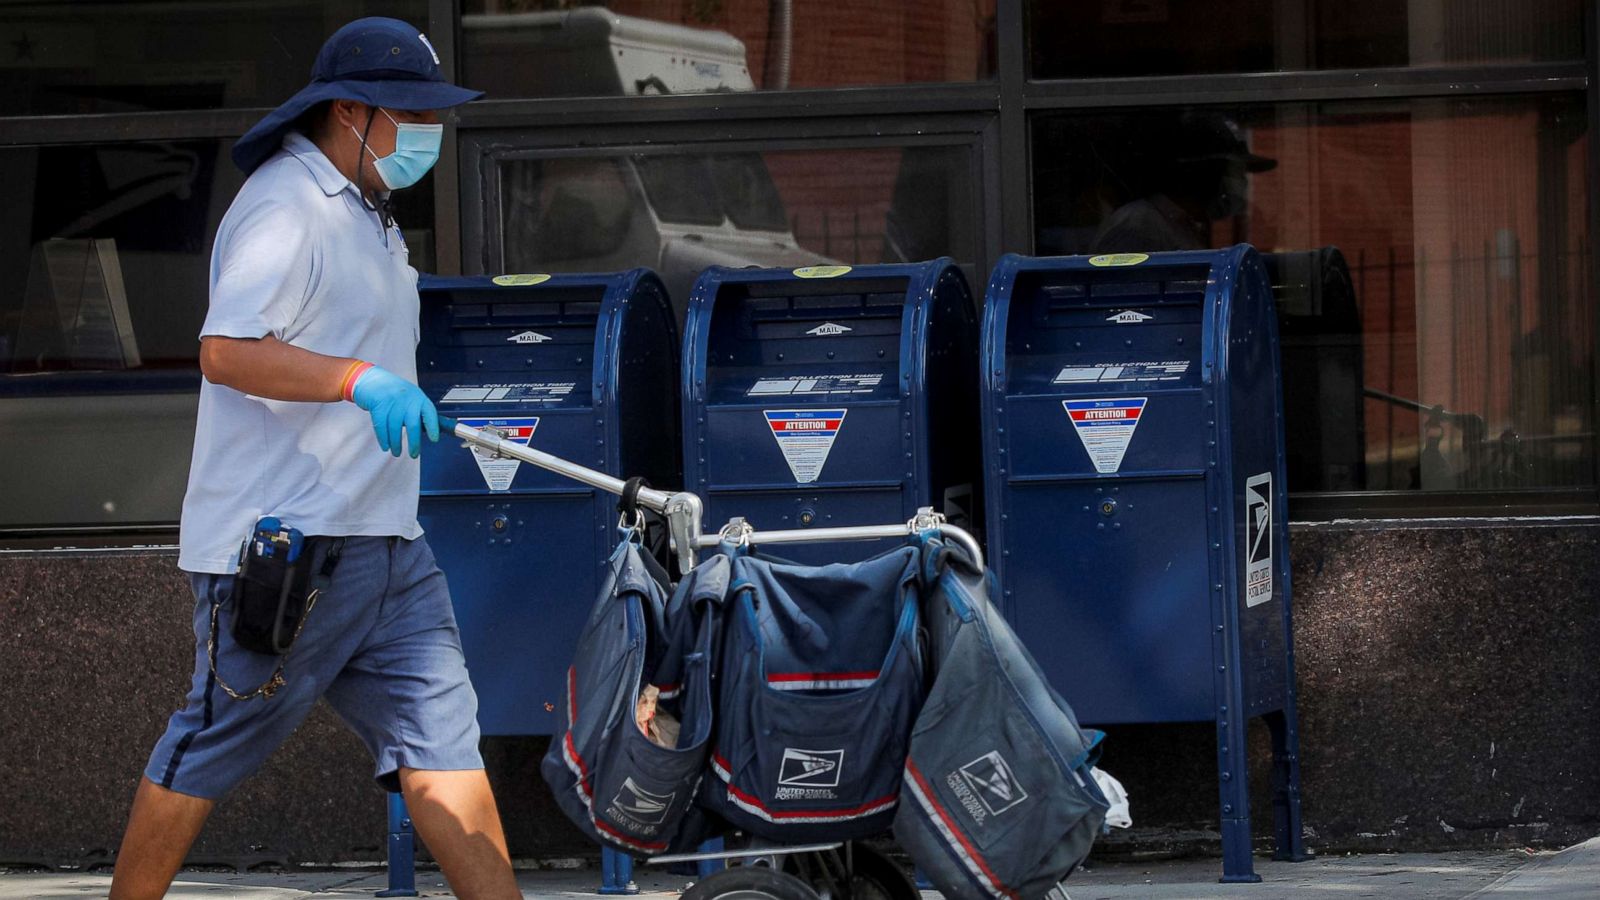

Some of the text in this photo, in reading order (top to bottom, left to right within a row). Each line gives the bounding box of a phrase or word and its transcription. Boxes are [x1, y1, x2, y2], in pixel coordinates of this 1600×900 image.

[819, 326, 839, 334] MAIL
[1085, 410, 1127, 419] ATTENTION
[785, 421, 827, 430] ATTENTION
[776, 786, 832, 796] UNITED STATES
[774, 792, 803, 800] POSTAL
